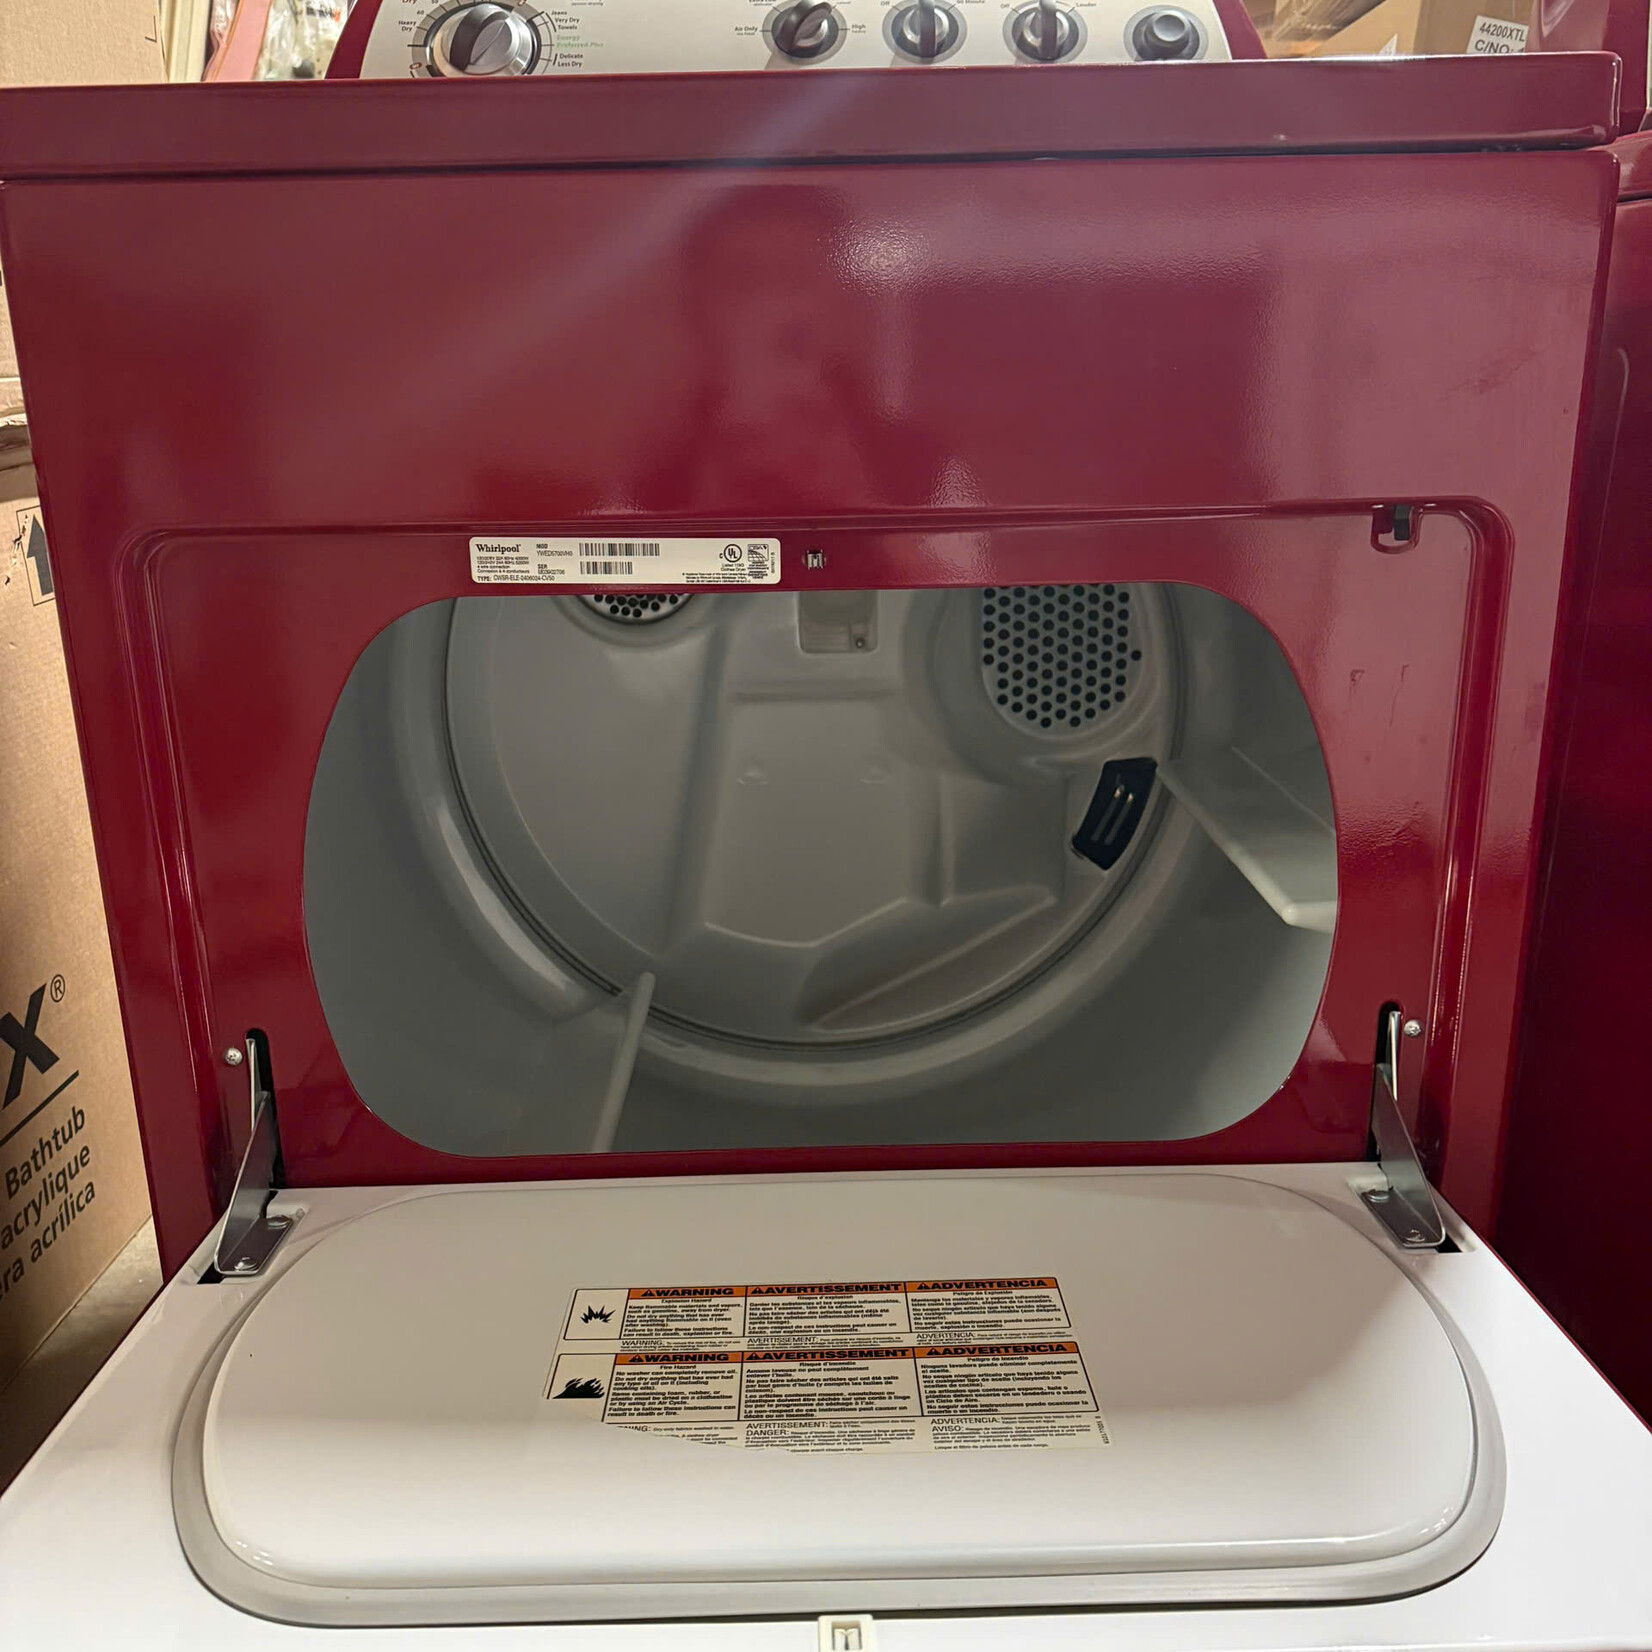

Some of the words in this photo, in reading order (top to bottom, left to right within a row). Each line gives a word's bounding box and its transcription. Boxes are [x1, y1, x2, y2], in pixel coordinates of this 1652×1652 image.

[1479, 22, 1525, 42] 44200XTL
[475, 543, 520, 555] Whirlpool
[5, 1106, 85, 1199] Bathtub
[1, 1145, 90, 1249] acrylique
[30, 1181, 95, 1264] acrílica
[764, 1284, 901, 1294] AVERTISSEMENT
[931, 1280, 1047, 1290] ADVERTENCIA
[656, 1288, 734, 1296] WARNING
[942, 1344, 1067, 1355] ADVERTENCIA
[645, 1354, 729, 1362] WARNING
[760, 1350, 909, 1360] AVERTISSEMENT
[746, 1421, 828, 1429] AVERTISSEMENT:
[931, 1417, 1000, 1425] ADVERTENCIA:
